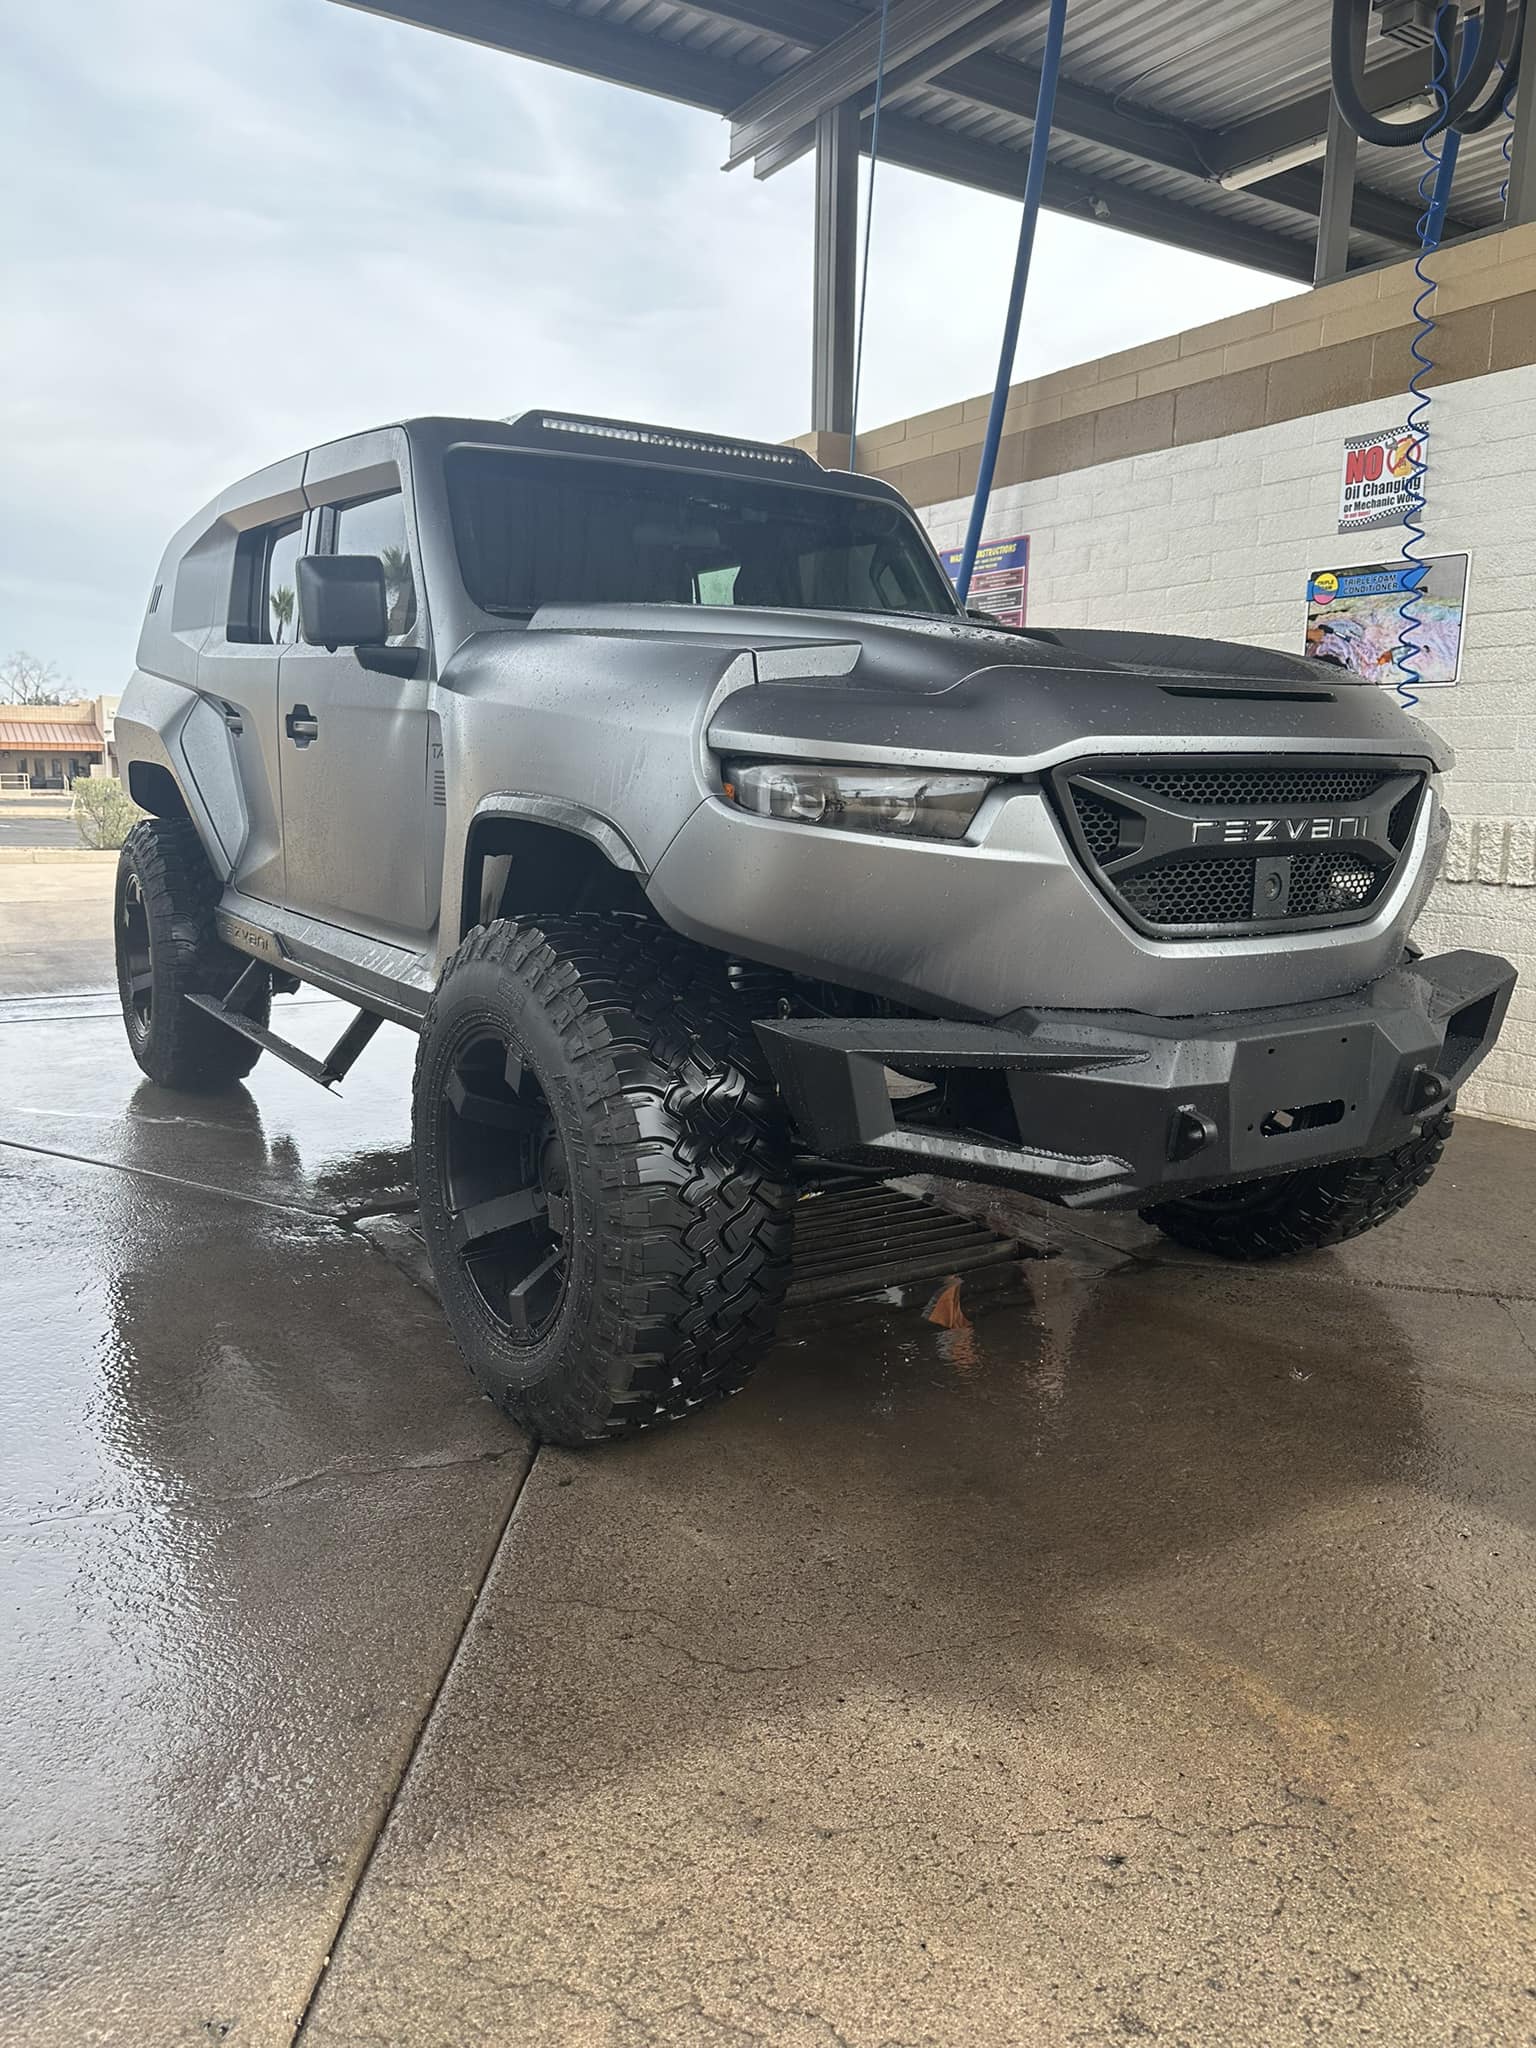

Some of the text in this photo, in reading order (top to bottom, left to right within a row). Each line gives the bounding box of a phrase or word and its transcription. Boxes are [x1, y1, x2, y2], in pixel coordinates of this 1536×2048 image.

[1345, 445, 1385, 485] NO
[1344, 477, 1421, 500] Oil Changing
[1343, 504, 1353, 513] or
[1353, 495, 1395, 511] Mechanic
[976, 543, 1017, 559] NSTRUCTIONS
[1343, 583, 1398, 594] CONDITIONER
[1344, 574, 1397, 586] TRIPLE FOAM
